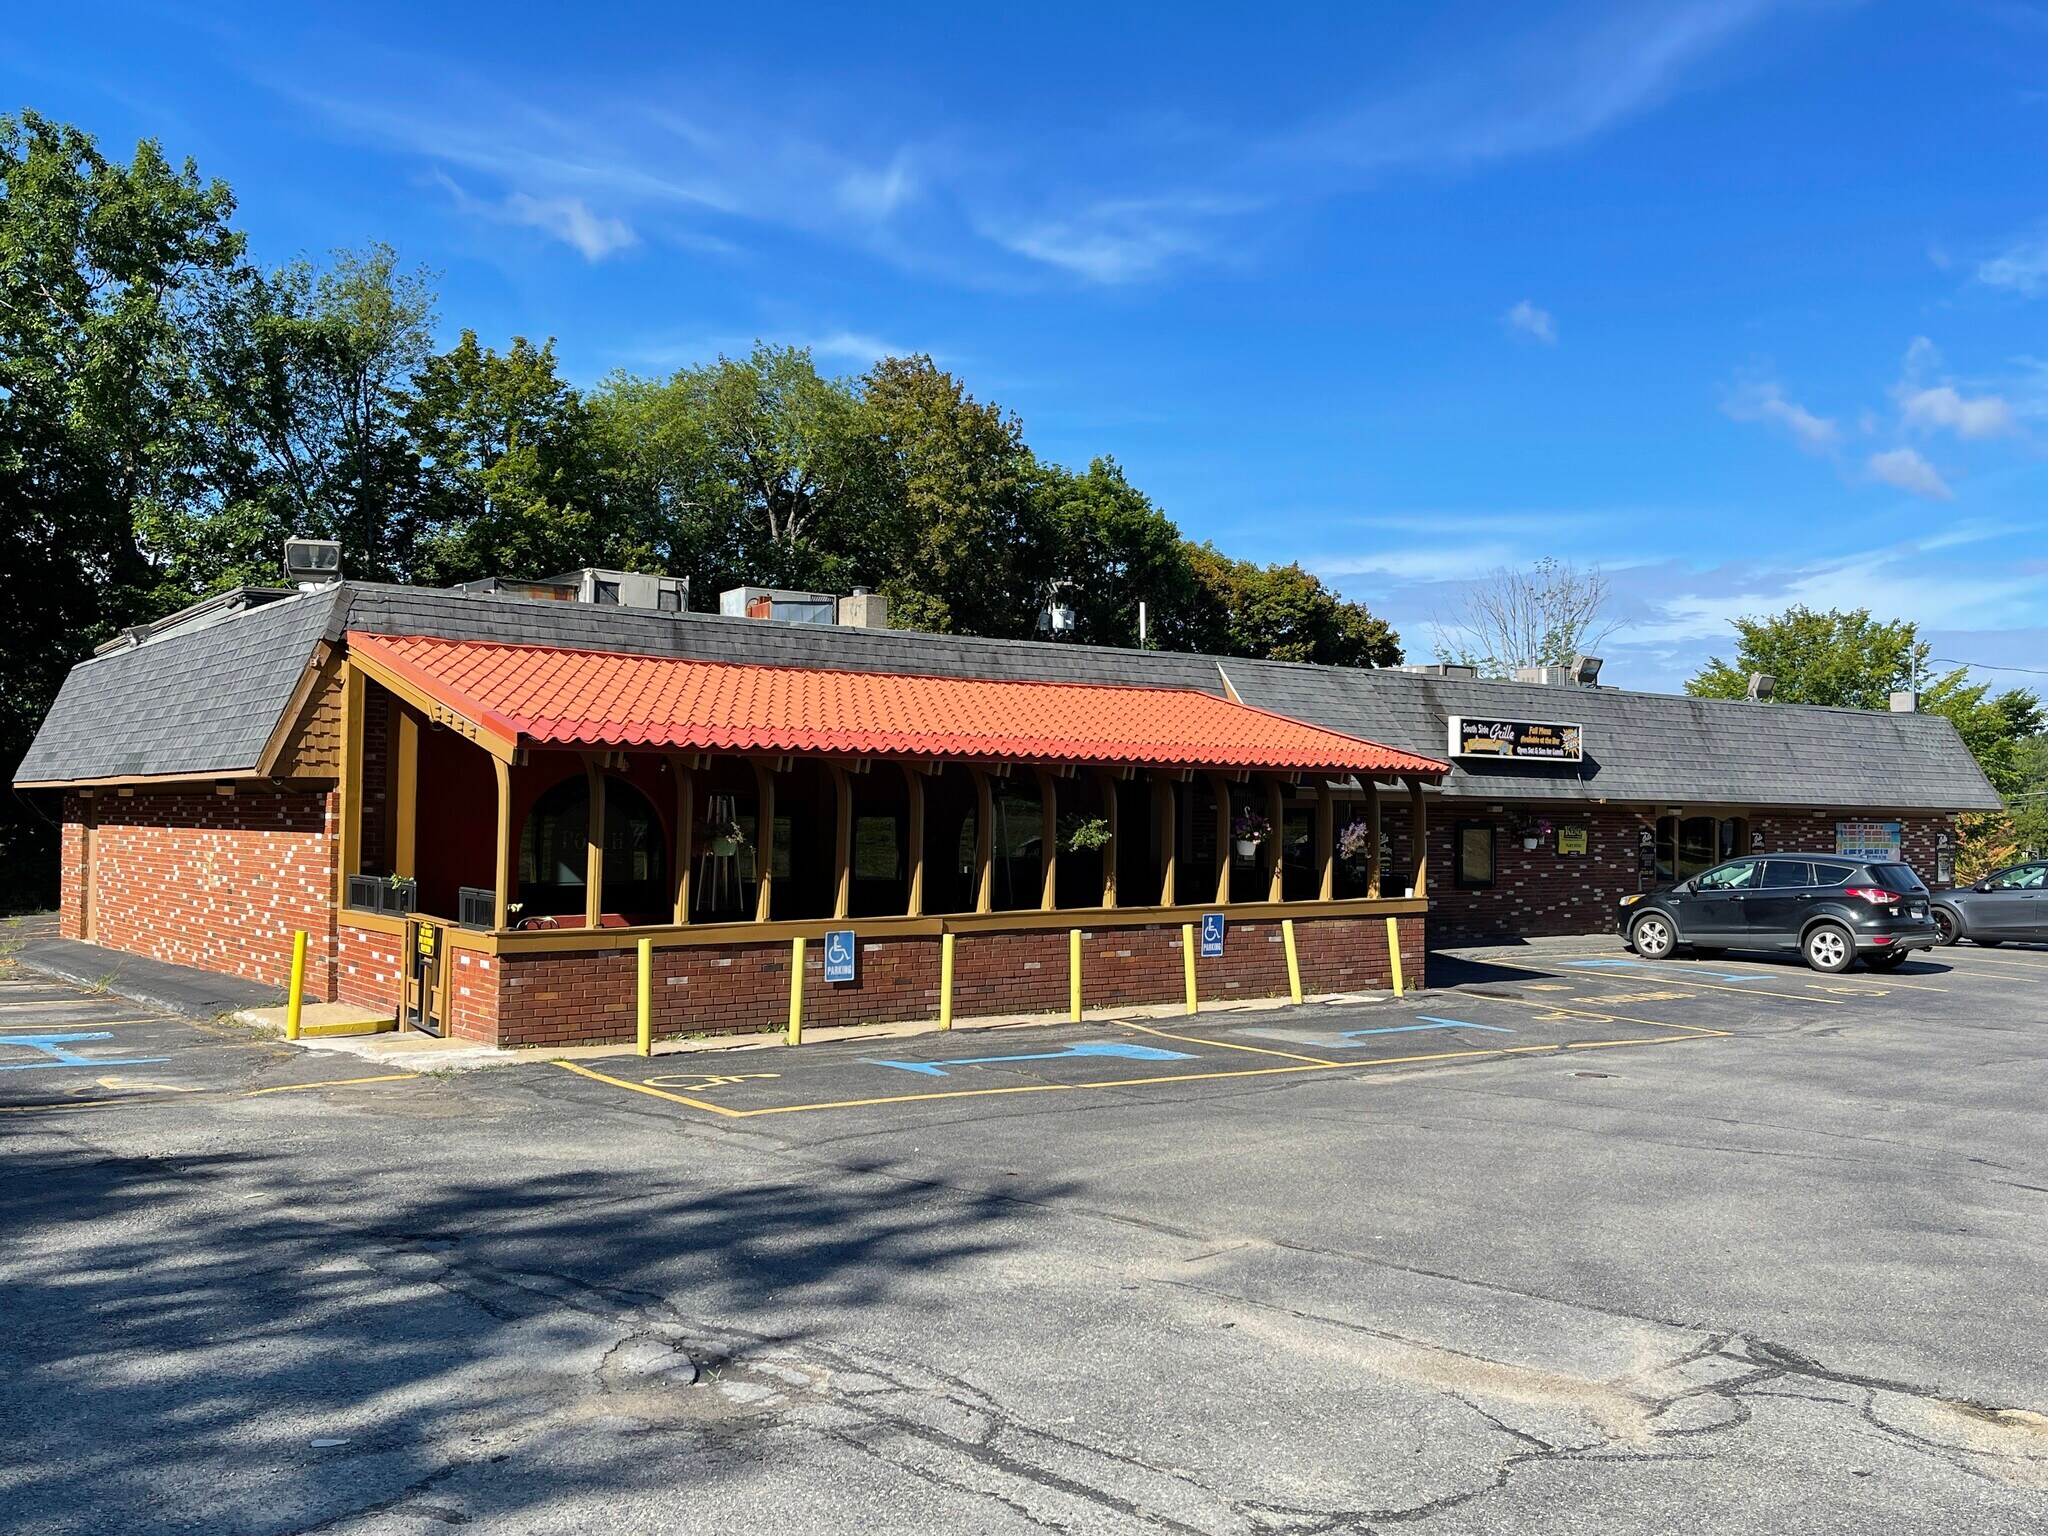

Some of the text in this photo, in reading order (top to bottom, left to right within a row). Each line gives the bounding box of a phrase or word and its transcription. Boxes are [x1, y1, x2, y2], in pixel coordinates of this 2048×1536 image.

[1462, 722, 1515, 742] South Side Grille
[1564, 826, 1582, 836] KENO
[1204, 943, 1221, 951] PARKING
[827, 965, 852, 975] PARKING
